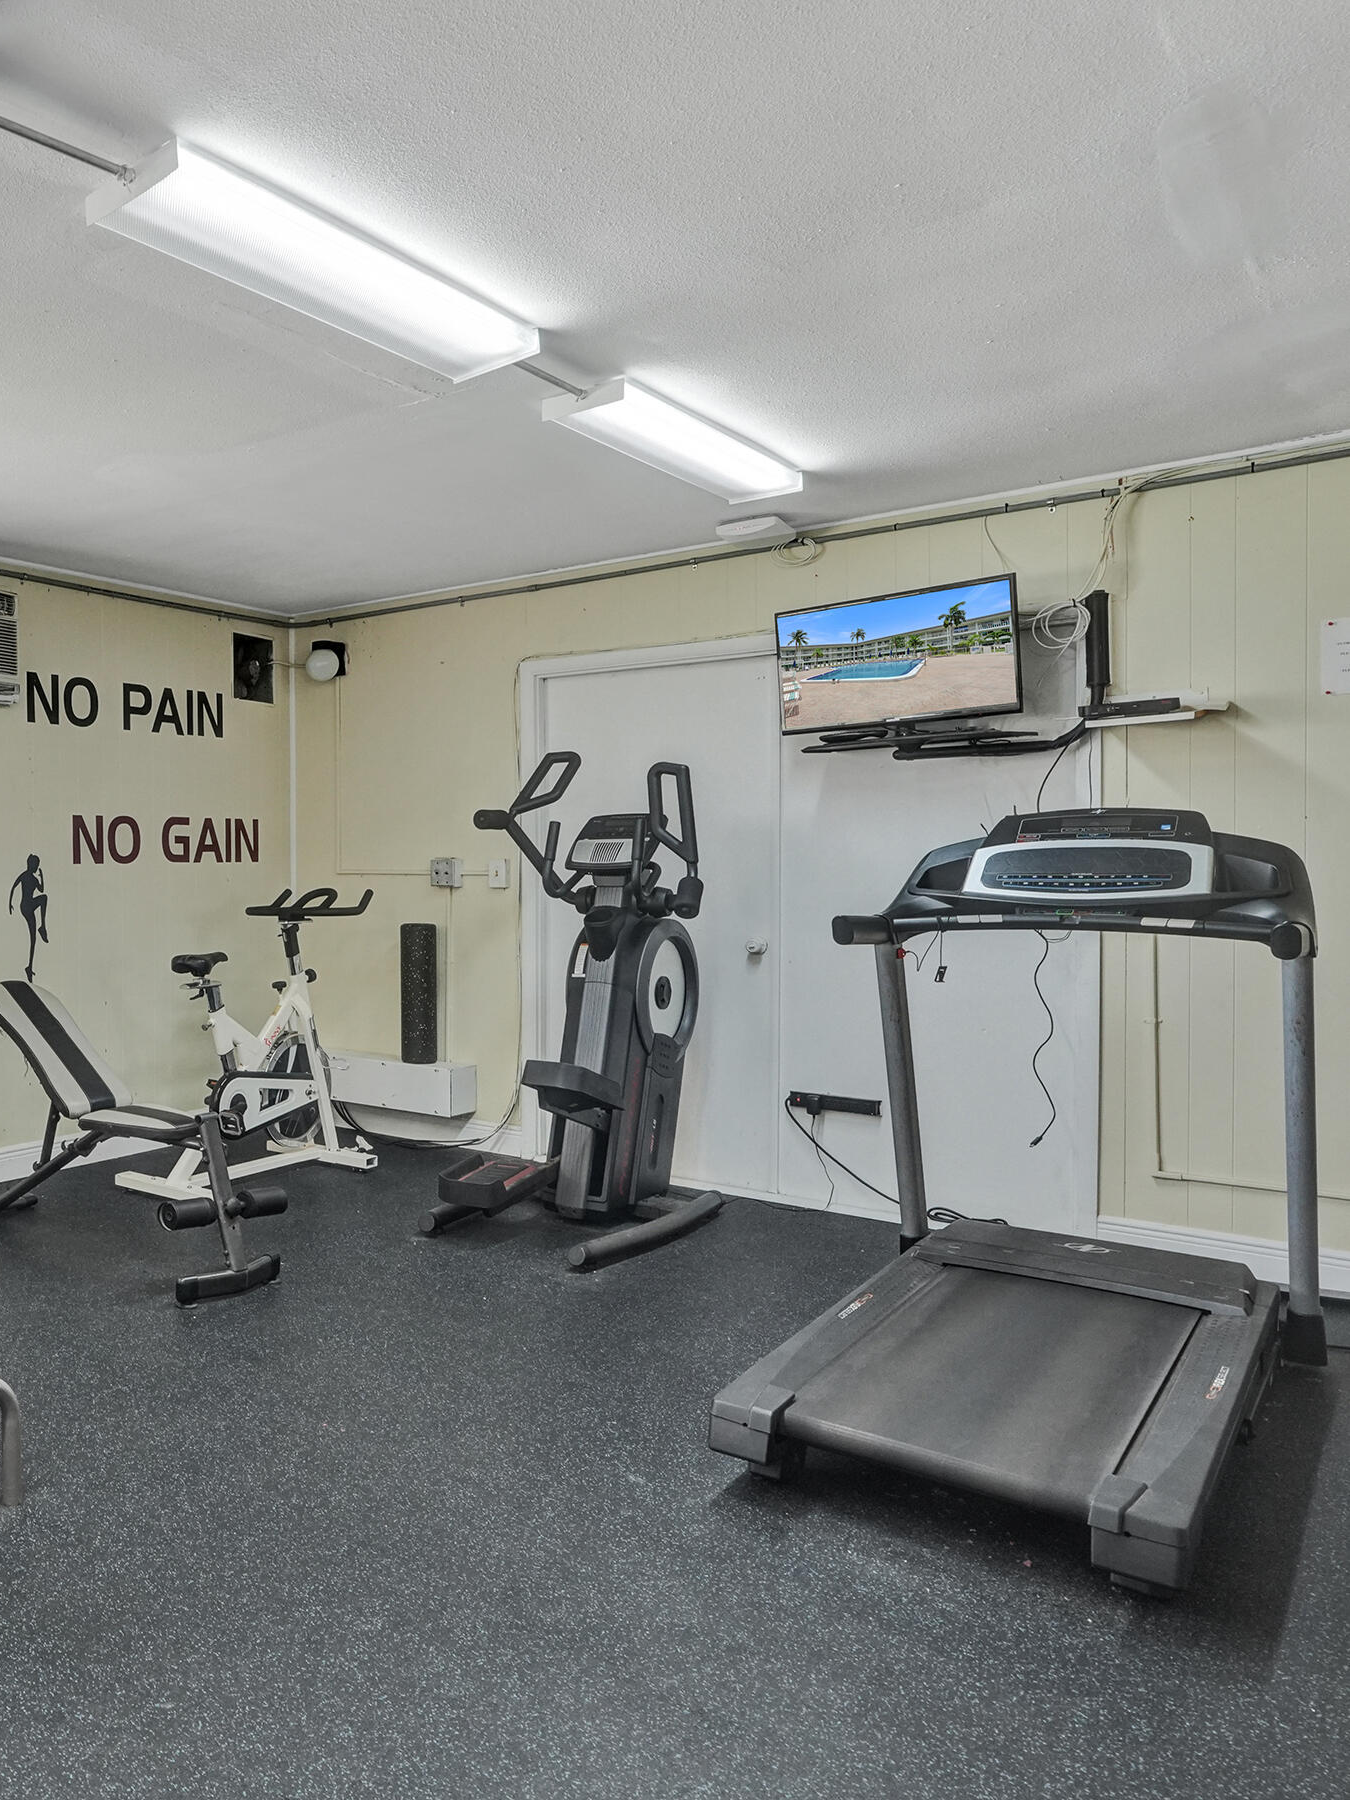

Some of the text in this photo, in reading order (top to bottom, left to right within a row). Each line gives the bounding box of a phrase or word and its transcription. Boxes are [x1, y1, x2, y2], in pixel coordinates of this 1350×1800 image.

[26, 671, 224, 738] NO PAIN
[72, 814, 260, 865] NO GAIN
